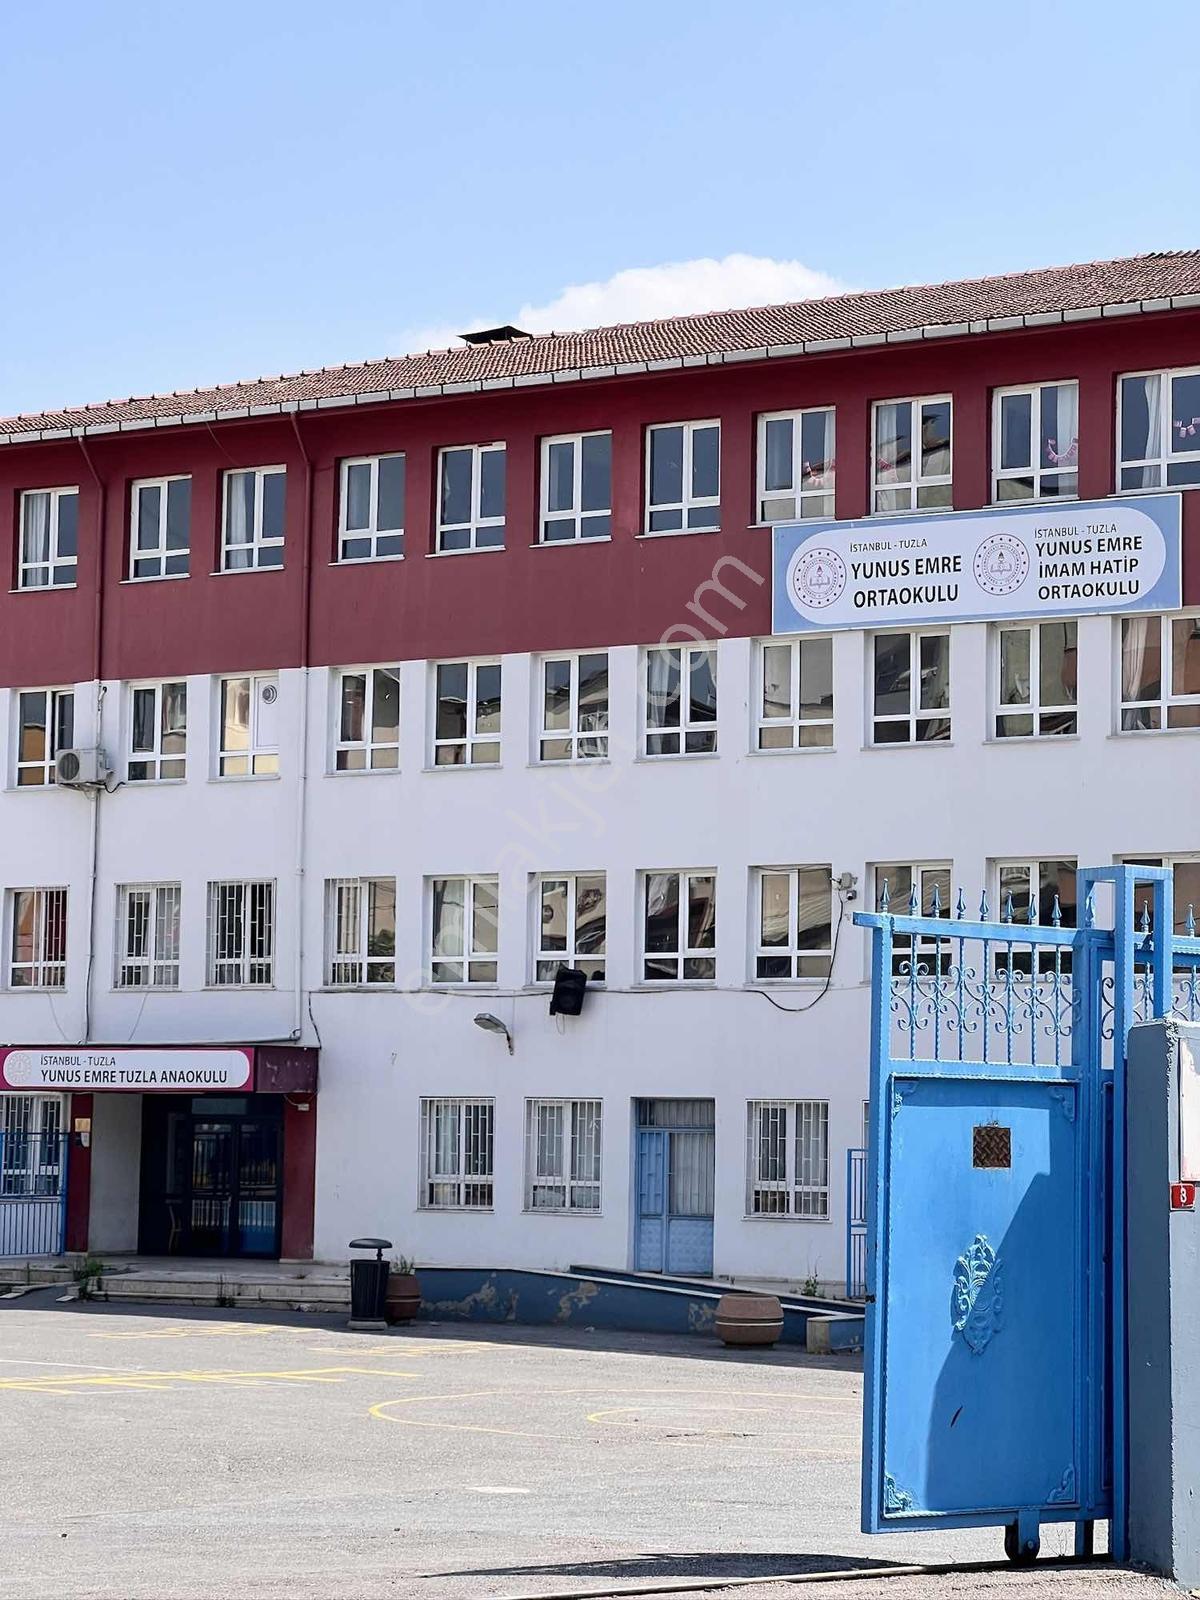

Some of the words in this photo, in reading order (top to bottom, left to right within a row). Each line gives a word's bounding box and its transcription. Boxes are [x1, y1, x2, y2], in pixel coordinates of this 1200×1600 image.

[1034, 526, 1079, 538] İSTANBUL
[1086, 524, 1117, 535] TUZLA
[850, 541, 892, 552] İSTANBUL
[899, 539, 928, 549] TUZLA
[1036, 540, 1092, 557] YUNUS
[1097, 536, 1143, 553] EMRE
[851, 560, 910, 580] YUNUS
[915, 555, 962, 575] EMRE
[1039, 561, 1085, 578] İMAM
[1091, 555, 1139, 575] HATİP
[854, 584, 959, 608] ORTAOKULU
[1038, 580, 1139, 600] ORTAOKULU
[40, 1054, 81, 1066] İSTANBUL
[88, 1056, 116, 1066] TUZLA
[41, 1070, 81, 1082] YUNUS
[84, 1070, 116, 1083] EMRE
[119, 1071, 157, 1083] TUZLA
[160, 1071, 228, 1083] ANAOKULU
[1180, 1187, 1187, 1203] 8
